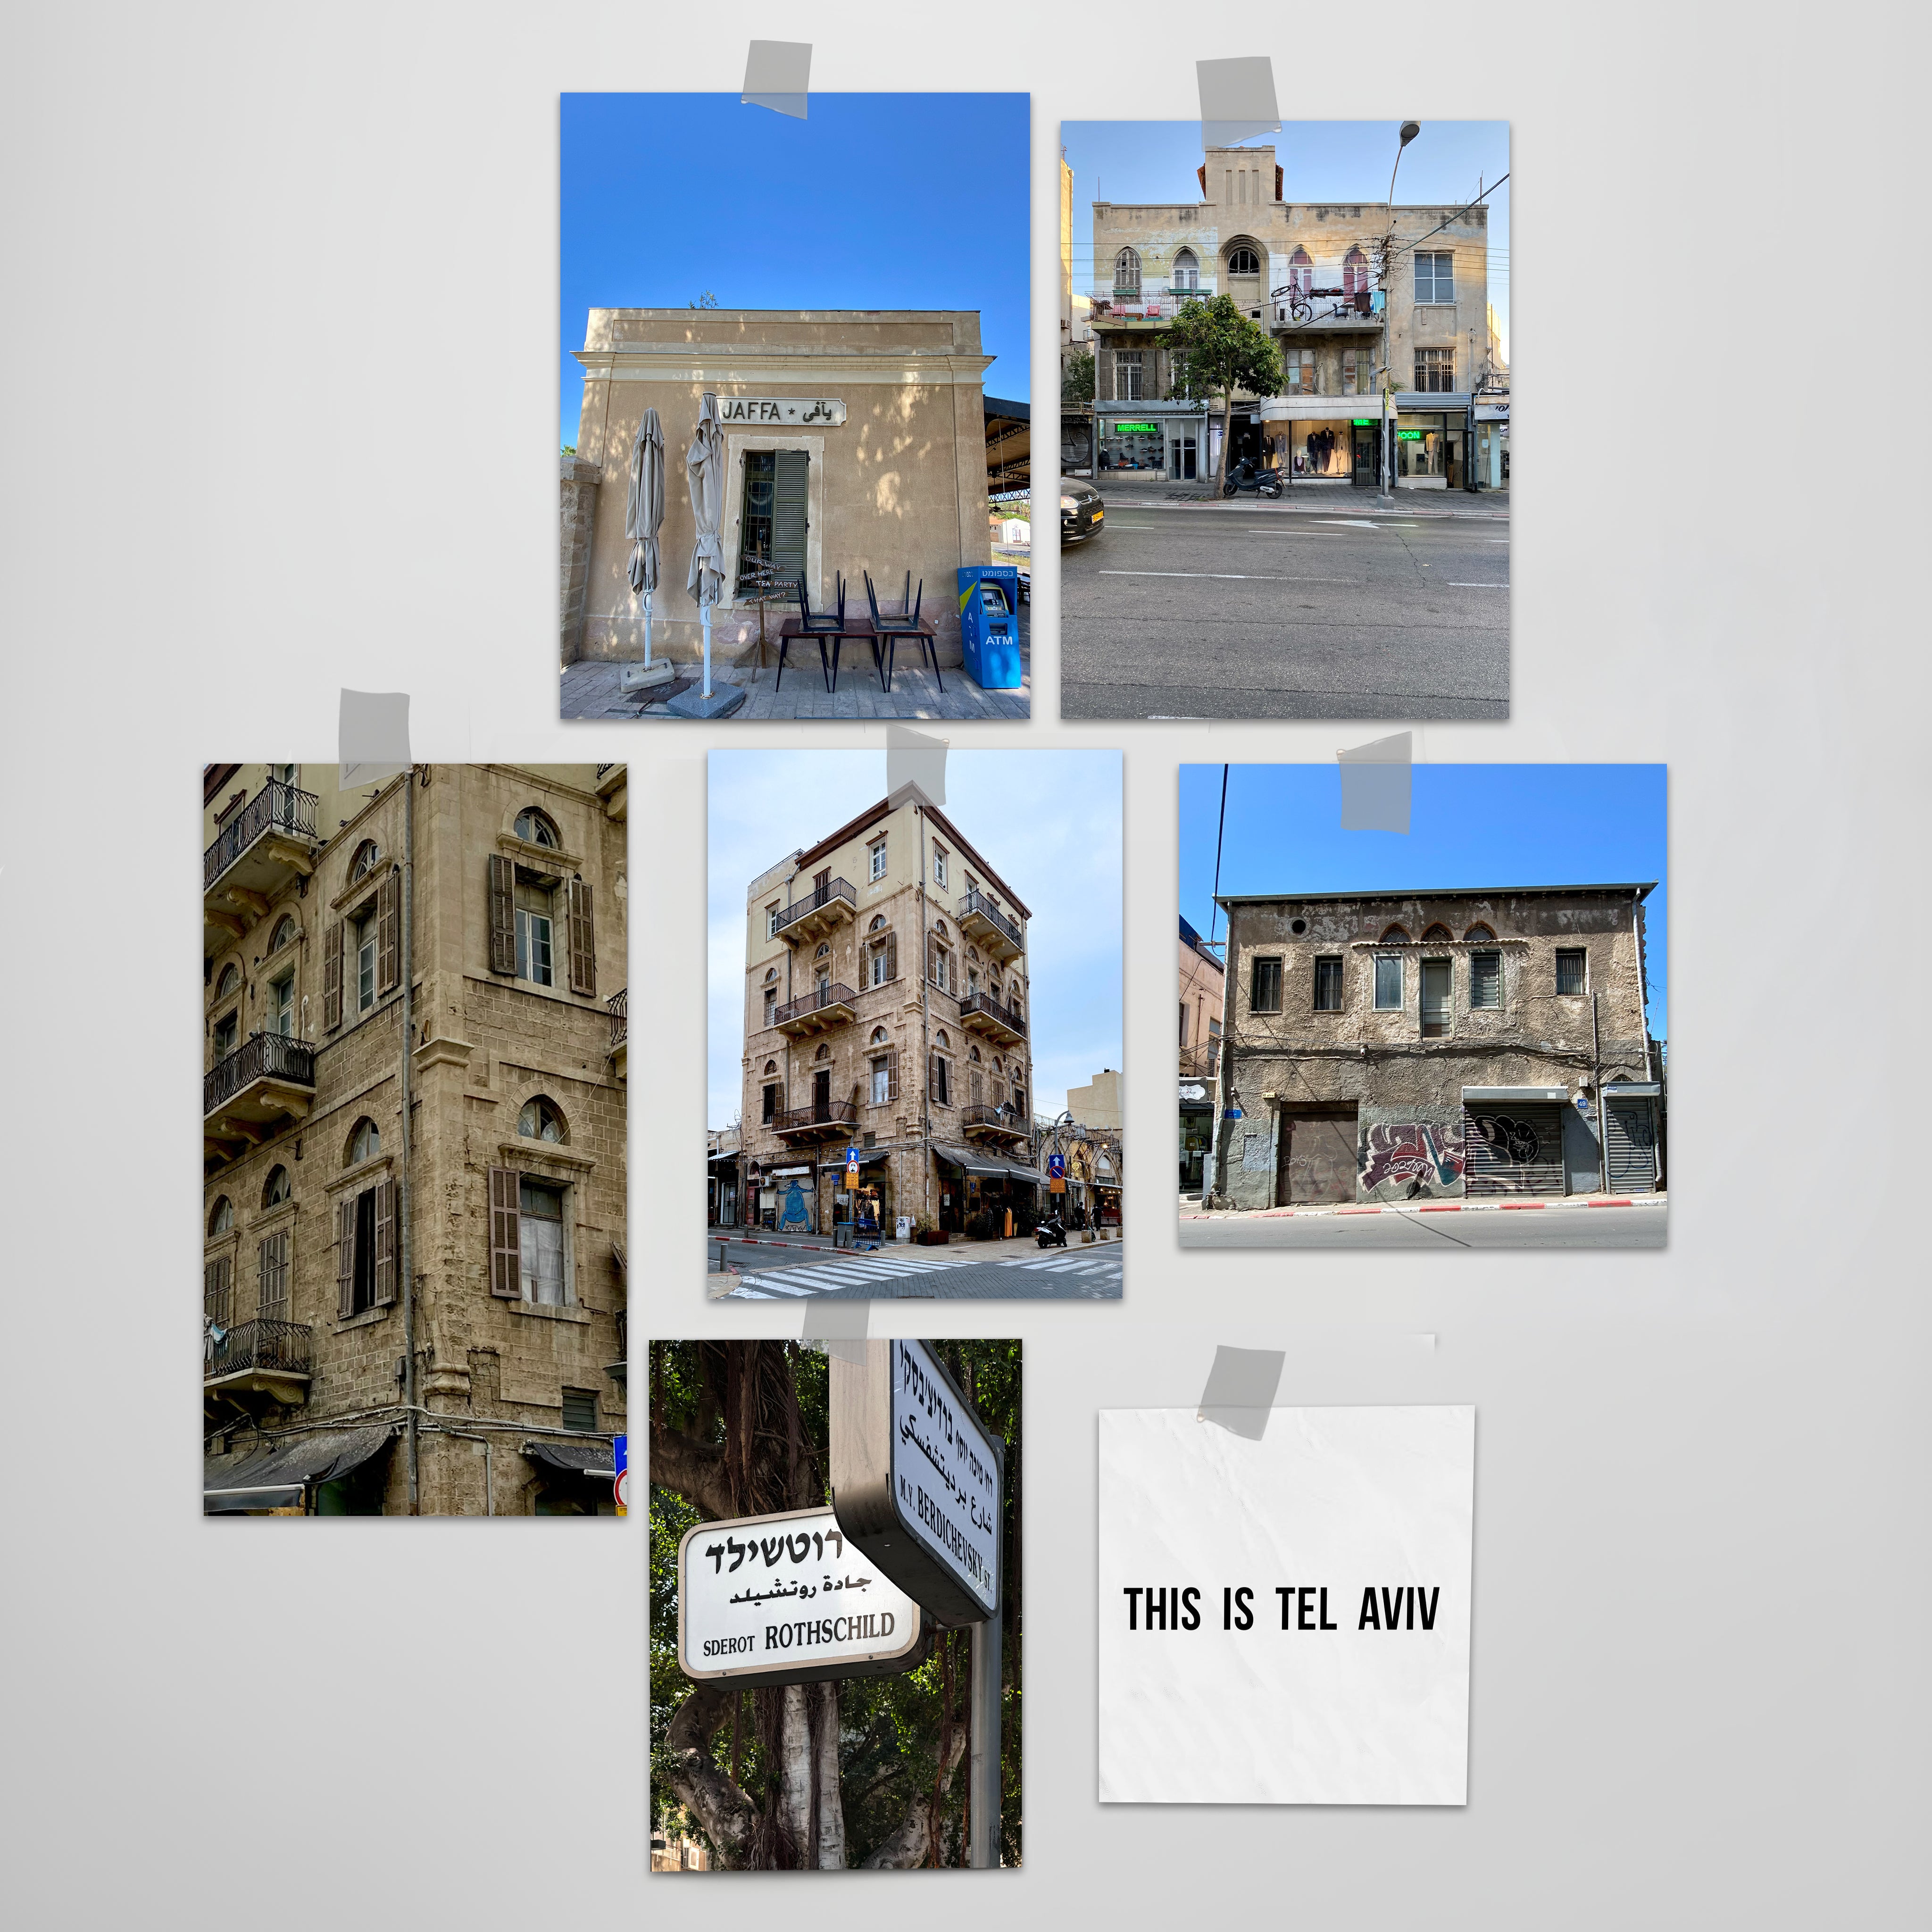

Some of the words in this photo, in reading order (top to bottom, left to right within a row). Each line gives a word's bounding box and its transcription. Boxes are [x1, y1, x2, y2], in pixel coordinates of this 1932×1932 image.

[723, 401, 780, 419] JAFFA
[740, 573, 757, 581] OVER
[745, 556, 764, 566] OUR
[765, 561, 781, 570] WAY
[749, 596, 766, 604] THAT
[769, 591, 786, 600] WAY?
[985, 636, 1013, 645] ATM
[956, 1429, 967, 1464] יוסף
[969, 1449, 983, 1485] מיכה
[971, 1496, 991, 1535] شارع
[917, 1485, 983, 1582] BERDICHEVSKY
[706, 1528, 843, 1574] רוטשילד
[730, 1578, 816, 1606] روتشيلد
[823, 1574, 872, 1592] جادة
[1124, 1586, 1201, 1631] THIS
[1224, 1586, 1254, 1631] IS
[1275, 1587, 1337, 1630] TEL
[1358, 1587, 1440, 1630] AVIV
[703, 1635, 755, 1657] SDEROT
[766, 1612, 895, 1650] ROTHSCHILD
